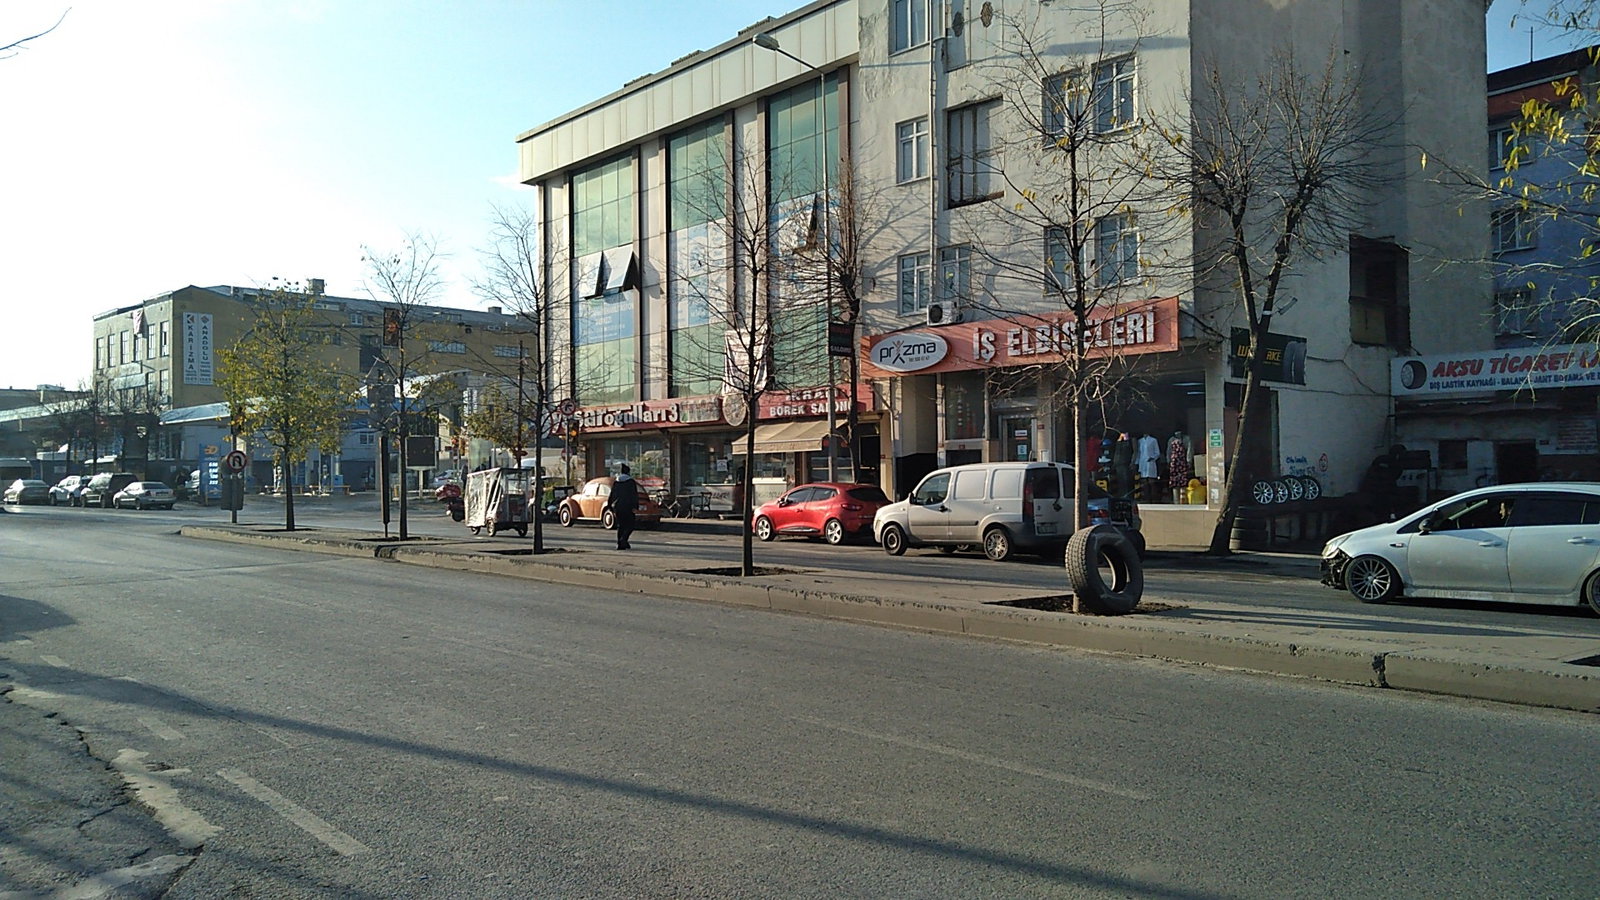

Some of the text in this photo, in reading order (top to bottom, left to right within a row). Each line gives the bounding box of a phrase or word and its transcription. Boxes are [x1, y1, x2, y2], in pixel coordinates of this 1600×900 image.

[201, 324, 209, 361] ANADOLU
[1432, 359, 1484, 378] AKSU
[1490, 353, 1575, 374] TİCARET
